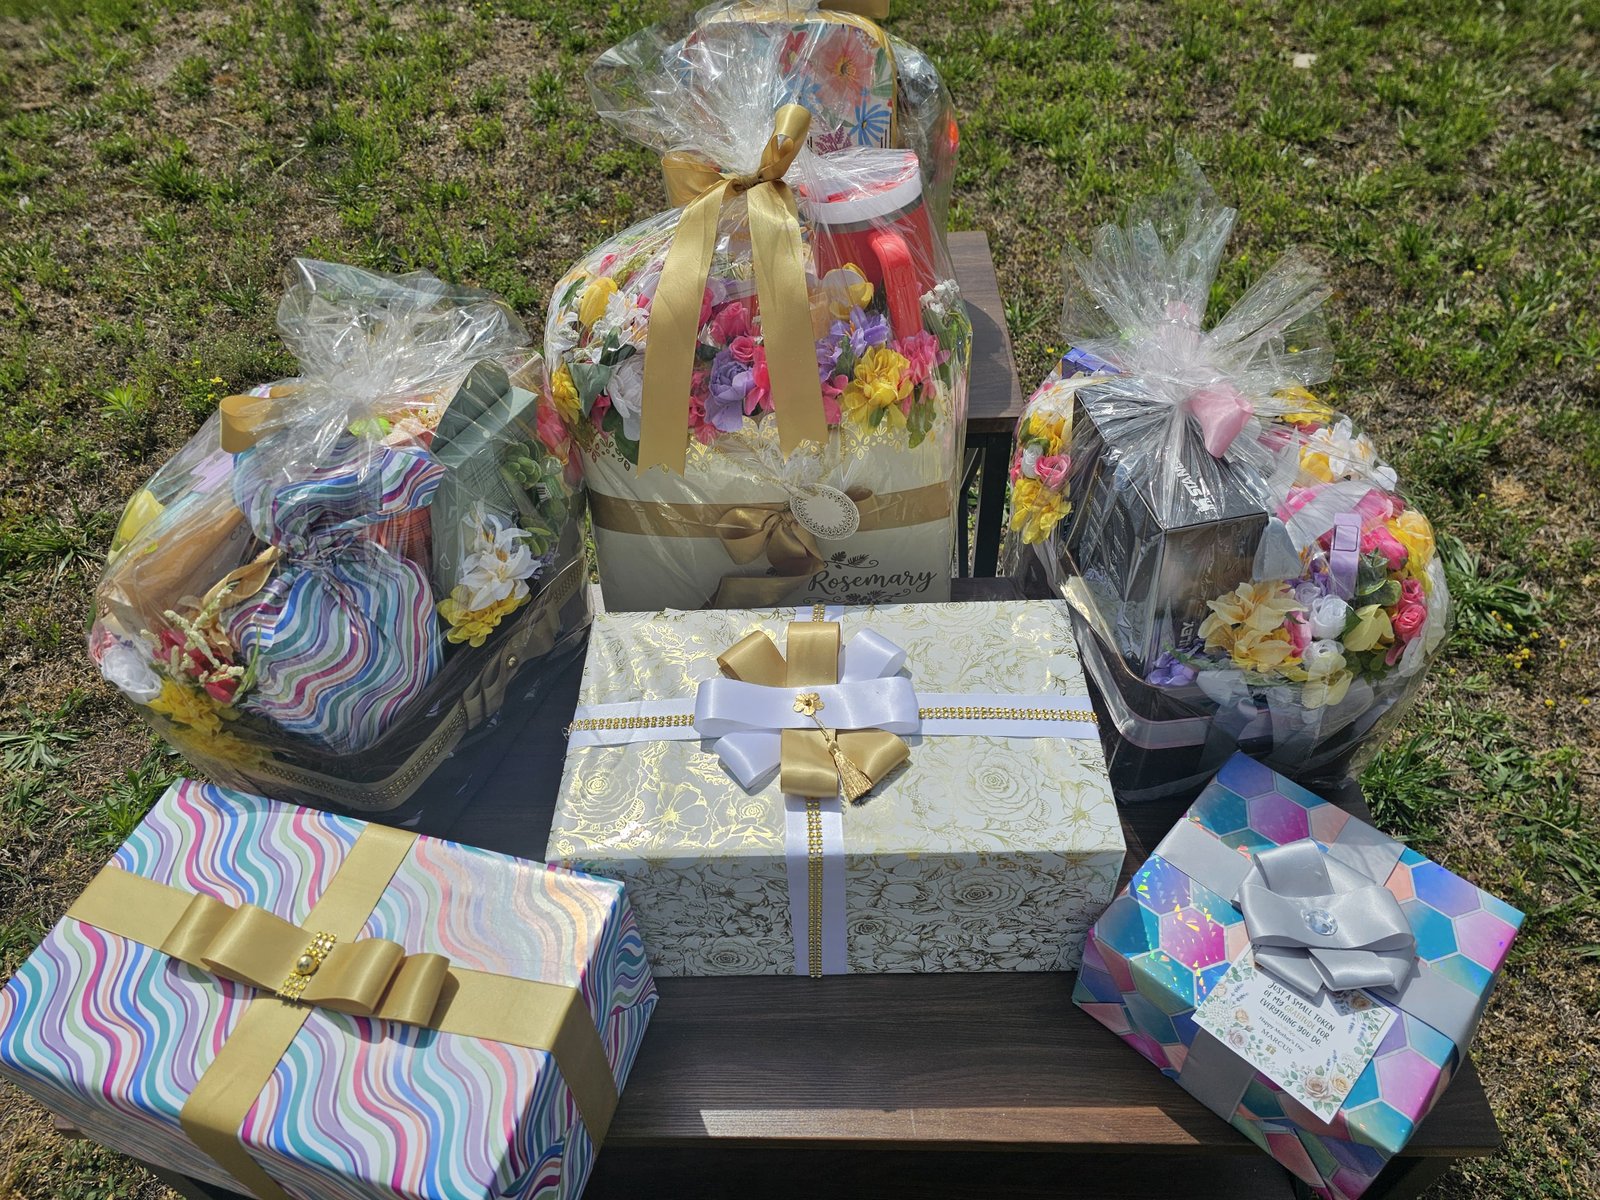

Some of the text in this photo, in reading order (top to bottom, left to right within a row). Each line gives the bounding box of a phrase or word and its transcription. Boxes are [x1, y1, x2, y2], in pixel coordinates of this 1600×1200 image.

[808, 570, 937, 595] Rosemary
[1259, 998, 1321, 1047] EVERYTHING YOU DO.
[1263, 989, 1330, 1041] OF MY GRATITUDE FOR
[1268, 982, 1285, 996] JUST
[1292, 998, 1312, 1016] SMALL
[1313, 1014, 1335, 1032] TOKEN
[1259, 1016, 1274, 1030] Happy
[1295, 1042, 1305, 1053] Day
[1261, 1028, 1293, 1054] MARCUS
